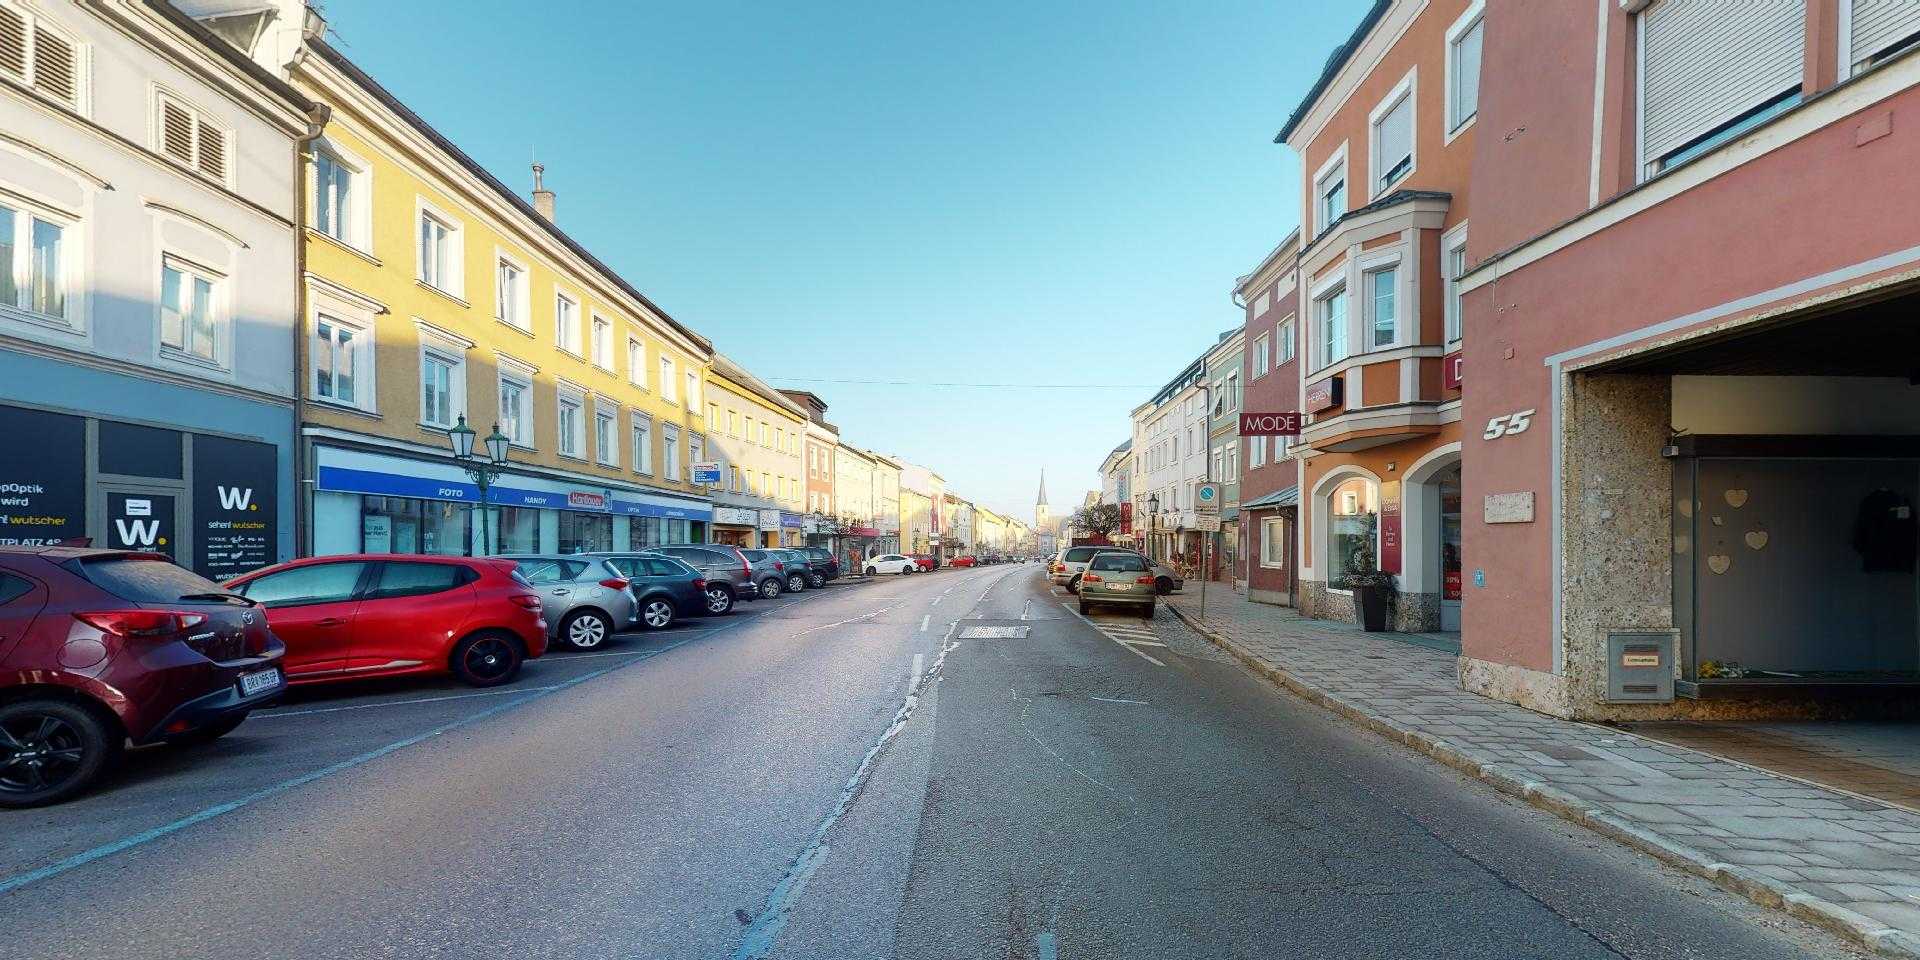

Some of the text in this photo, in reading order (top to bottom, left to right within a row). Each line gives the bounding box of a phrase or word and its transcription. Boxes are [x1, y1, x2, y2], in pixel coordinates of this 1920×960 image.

[1245, 416, 1295, 431] MODE
[1483, 409, 1536, 440] 55
[0, 483, 44, 494] pOptik
[438, 488, 464, 498] FOTO
[10, 516, 66, 526] wutscher
